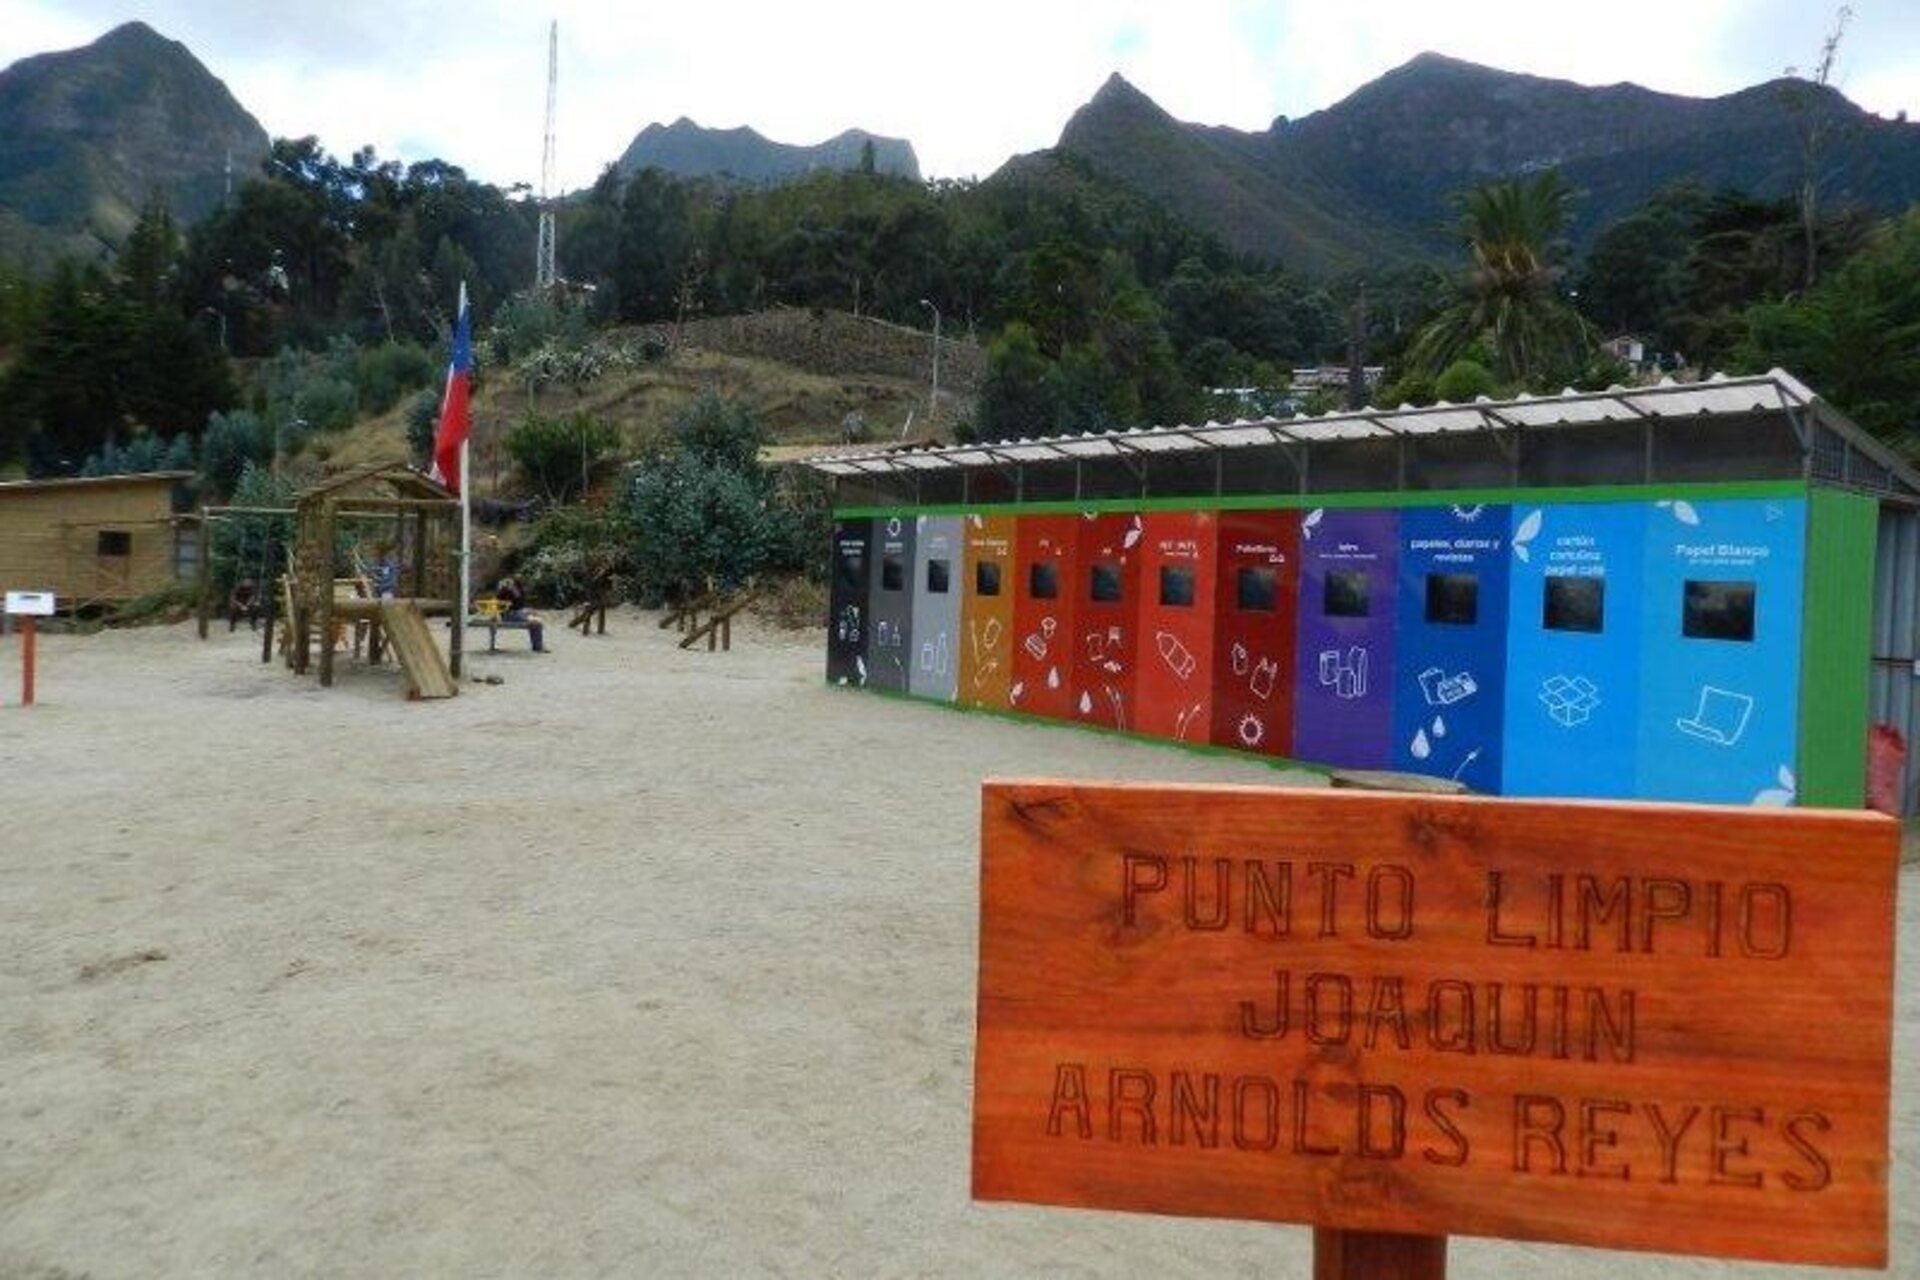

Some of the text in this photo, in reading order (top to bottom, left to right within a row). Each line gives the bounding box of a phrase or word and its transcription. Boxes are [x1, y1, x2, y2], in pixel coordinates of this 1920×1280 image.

[1121, 854, 1794, 961] PUNTO LIMPIO
[1240, 969, 1636, 1063] JOAQUIN
[1046, 1062, 1833, 1192] ARNOLDS REYES
